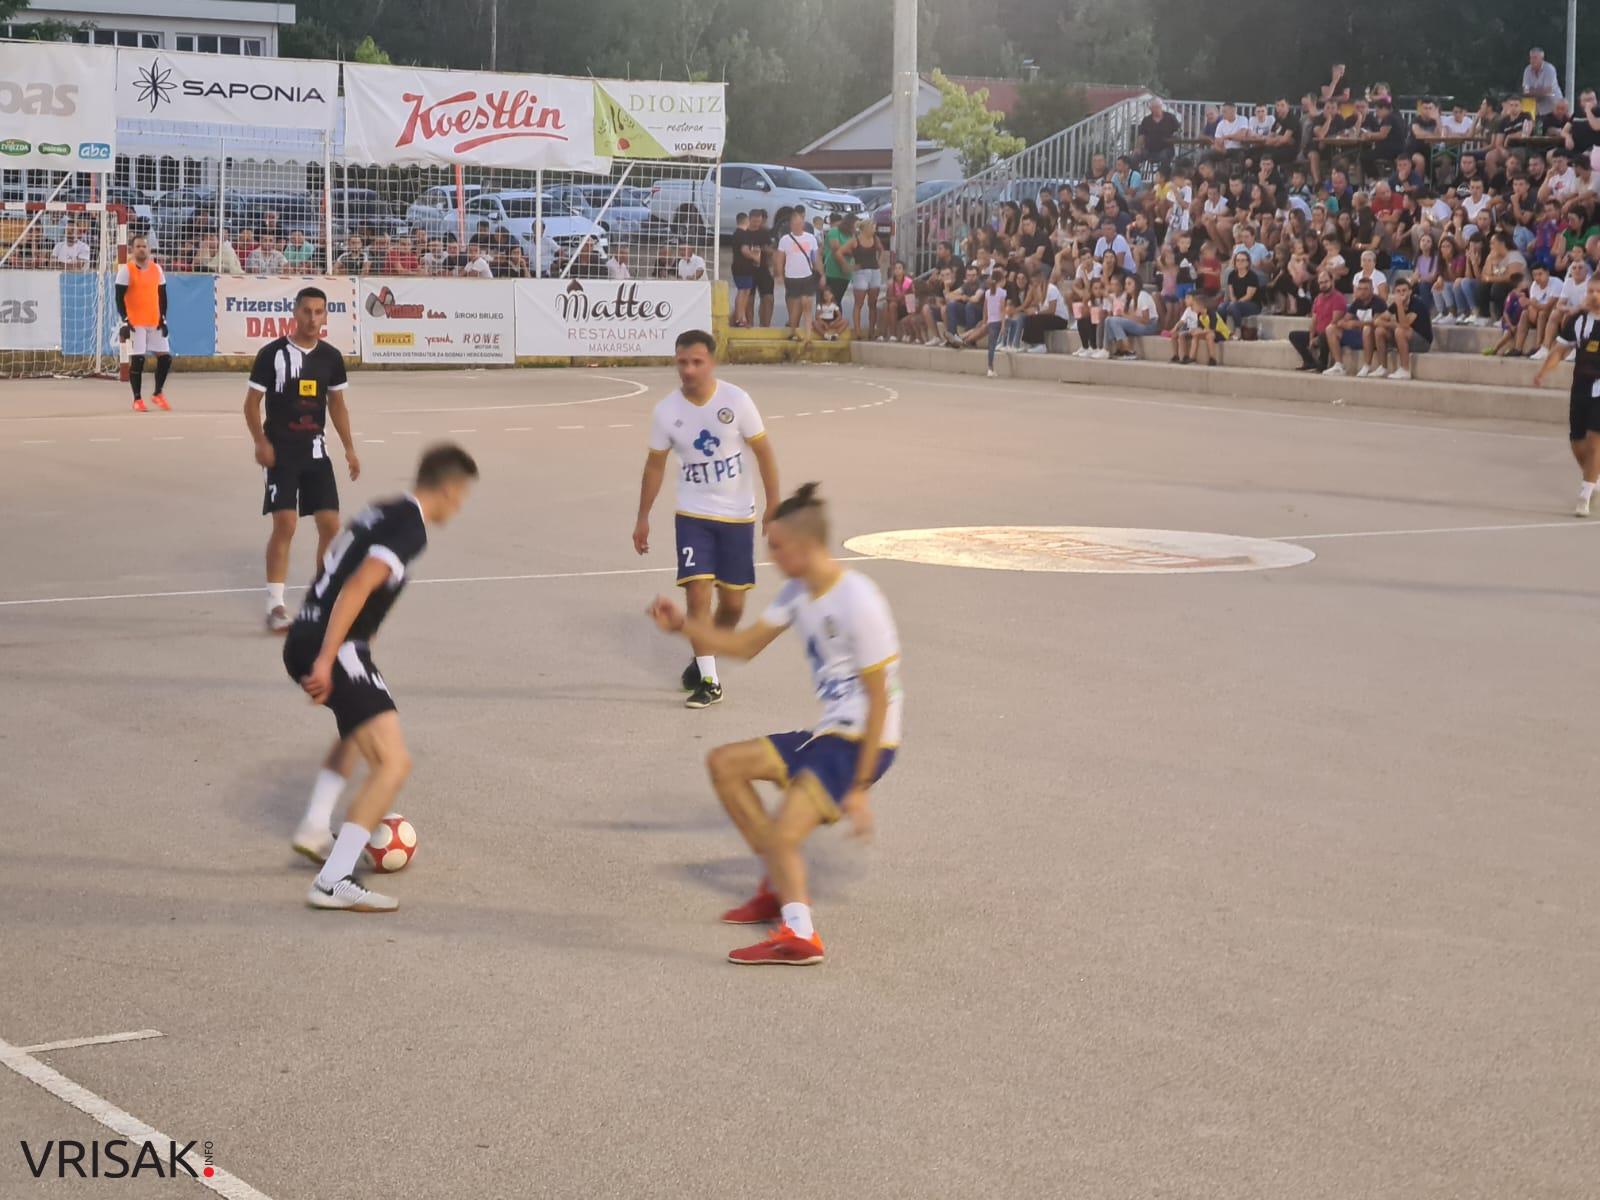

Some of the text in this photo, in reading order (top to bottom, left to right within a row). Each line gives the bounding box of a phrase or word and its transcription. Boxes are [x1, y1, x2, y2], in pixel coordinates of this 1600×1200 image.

[182, 79, 325, 103] SAPONIA
[629, 94, 722, 113] DIONIZ
[395, 89, 566, 148] Koestlin
[665, 122, 704, 132] restoran
[80, 144, 109, 157] abc
[674, 143, 693, 151] KOD
[555, 282, 673, 323] Matteo
[454, 311, 478, 319] ŠIROKI
[463, 333, 501, 344] ROWE
[568, 328, 668, 340] RESTAURANT
[588, 343, 642, 353] MAKARSKA
[714, 452, 742, 482] PET
[682, 546, 696, 567] 2
